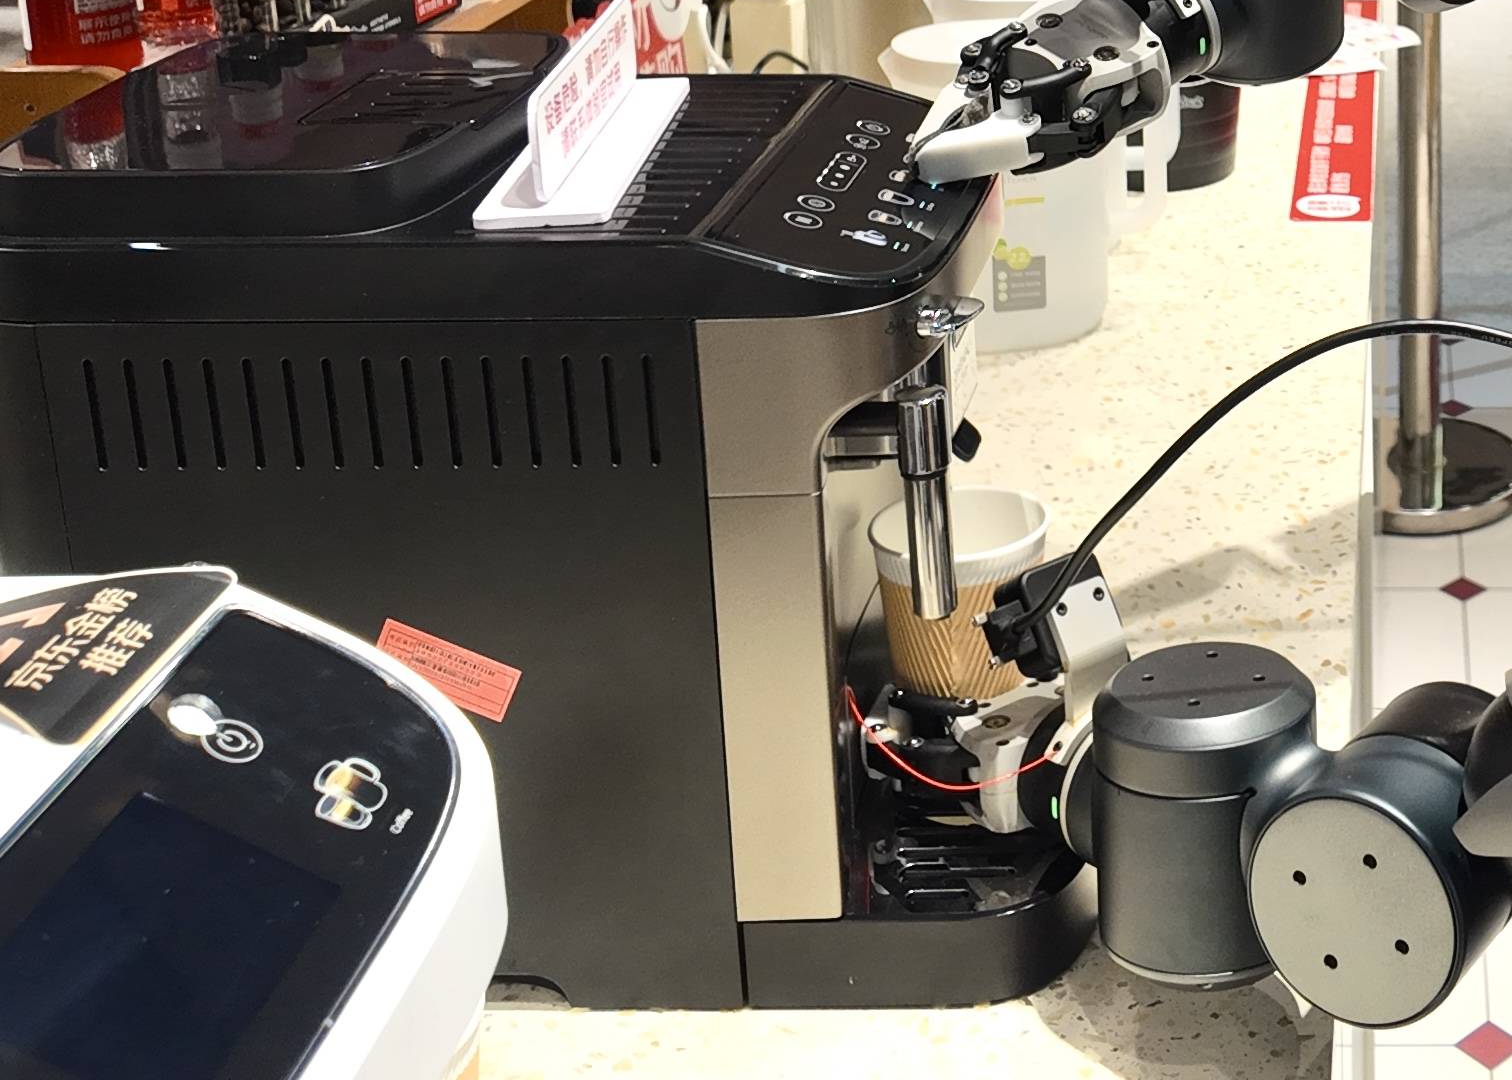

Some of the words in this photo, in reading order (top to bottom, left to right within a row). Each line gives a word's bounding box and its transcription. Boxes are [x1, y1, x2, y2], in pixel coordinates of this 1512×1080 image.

[4, 588, 138, 691] 京东金榜
[79, 618, 153, 676] 推荐
